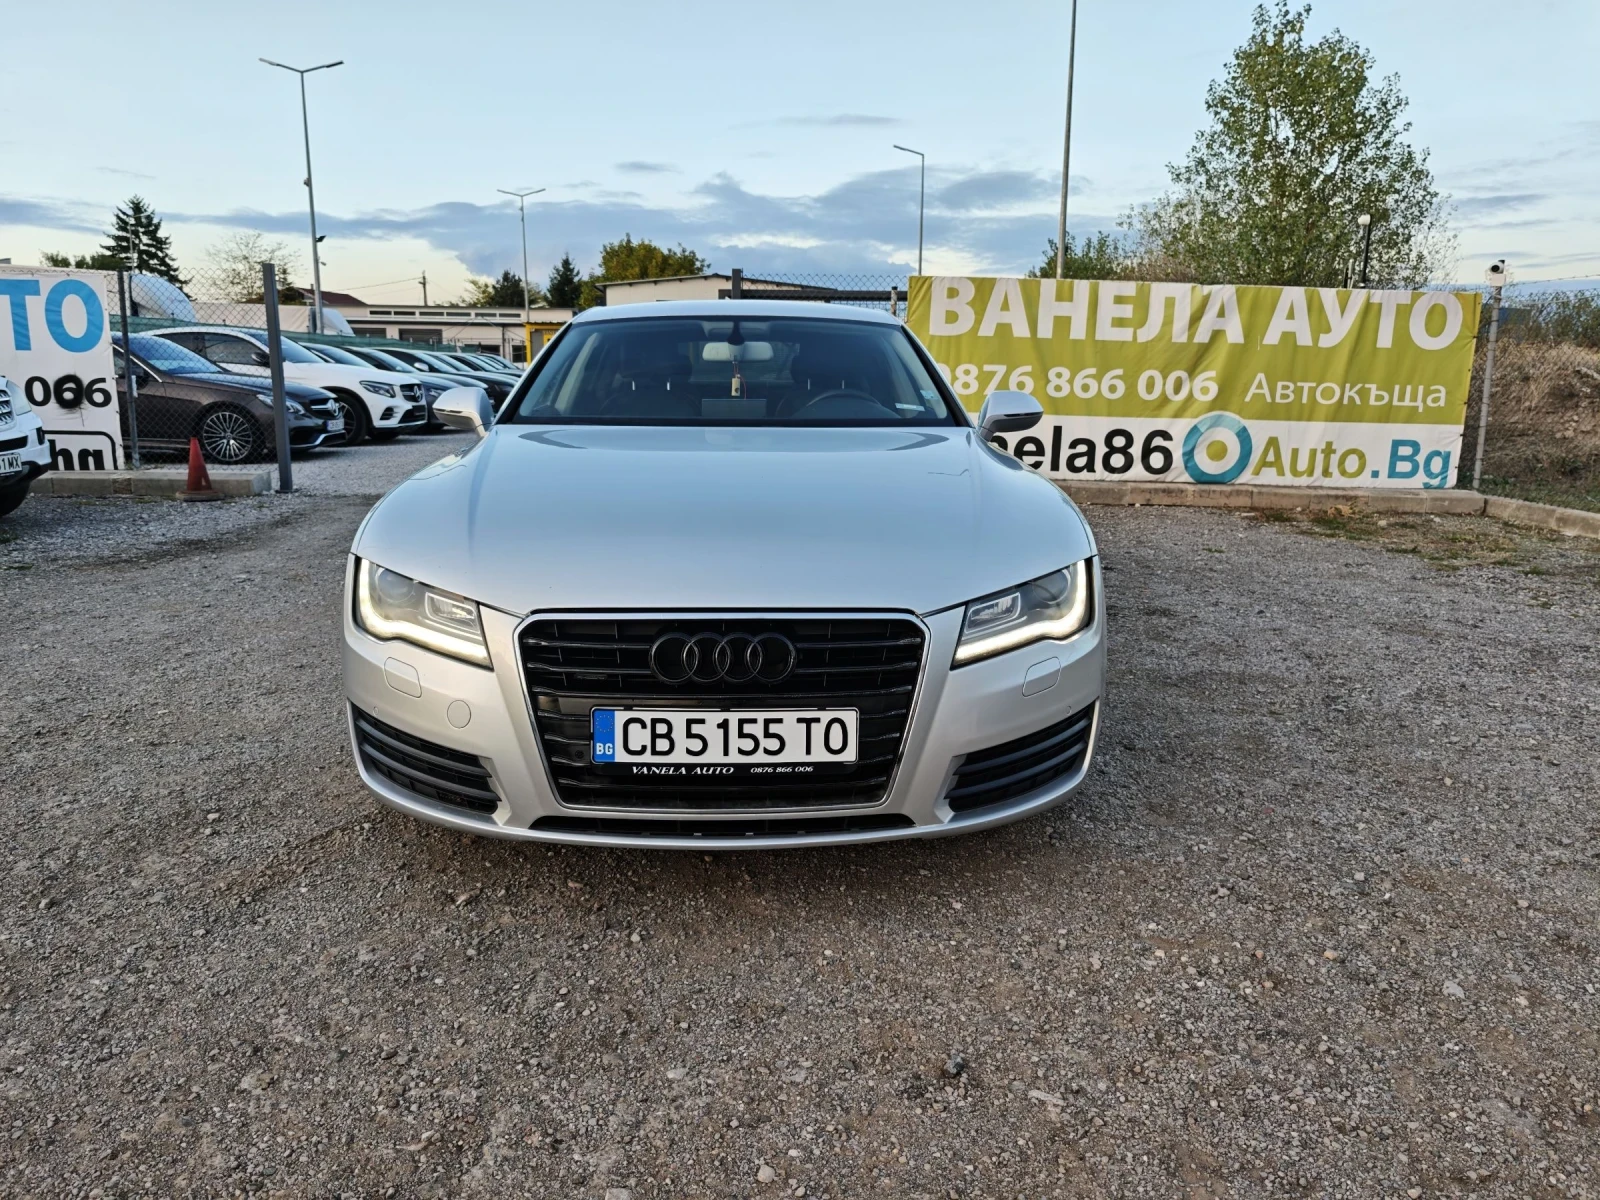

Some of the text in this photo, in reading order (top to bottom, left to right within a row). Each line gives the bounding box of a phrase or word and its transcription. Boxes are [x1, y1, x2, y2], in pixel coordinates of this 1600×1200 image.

[929, 277, 1463, 350] ВАНЕЛА АУТО
[1046, 366, 1126, 401] 866
[1137, 369, 1219, 402] 006
[1244, 372, 1446, 413] Автокъща
[596, 743, 613, 755] BG
[632, 766, 687, 775] VANELA
[691, 766, 734, 775] AUTO
[795, 765, 814, 773] 006
